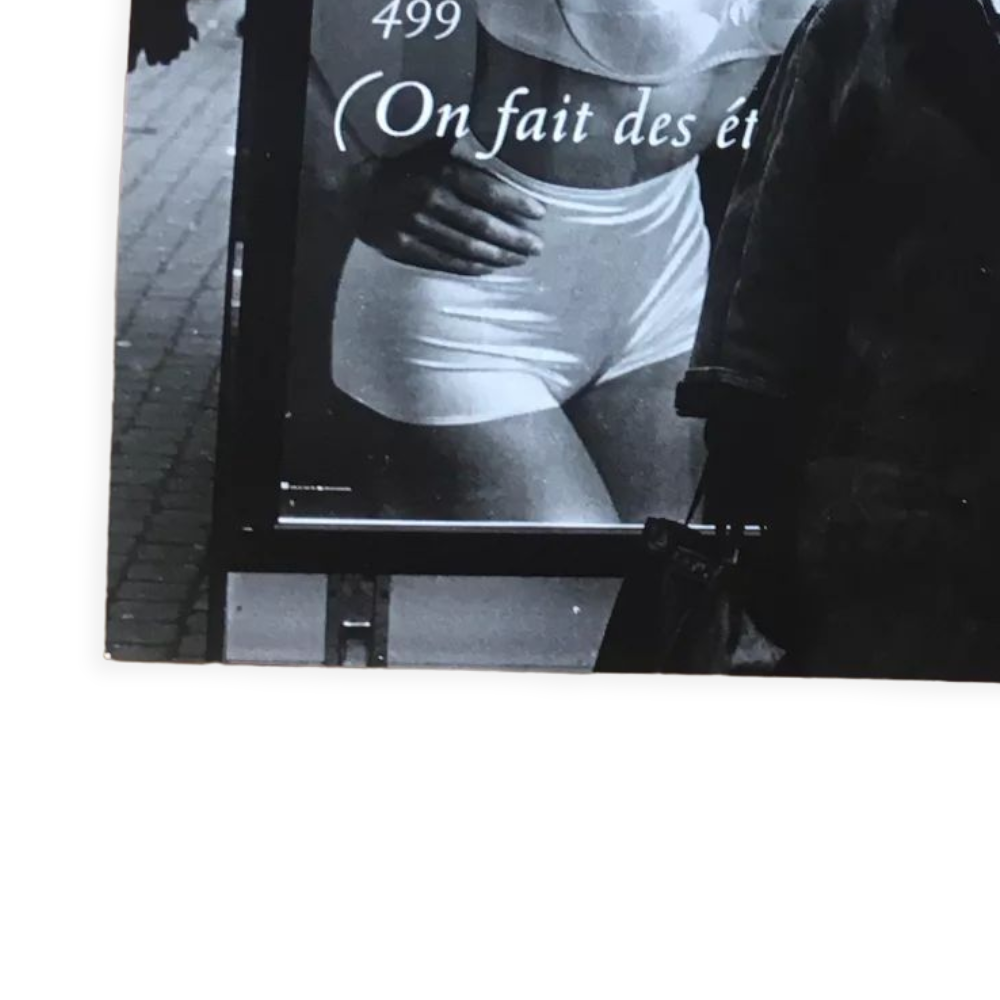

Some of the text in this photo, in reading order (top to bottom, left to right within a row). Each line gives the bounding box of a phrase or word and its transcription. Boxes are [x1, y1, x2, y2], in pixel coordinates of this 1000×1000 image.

[333, 70, 760, 160] (On fait des ét
